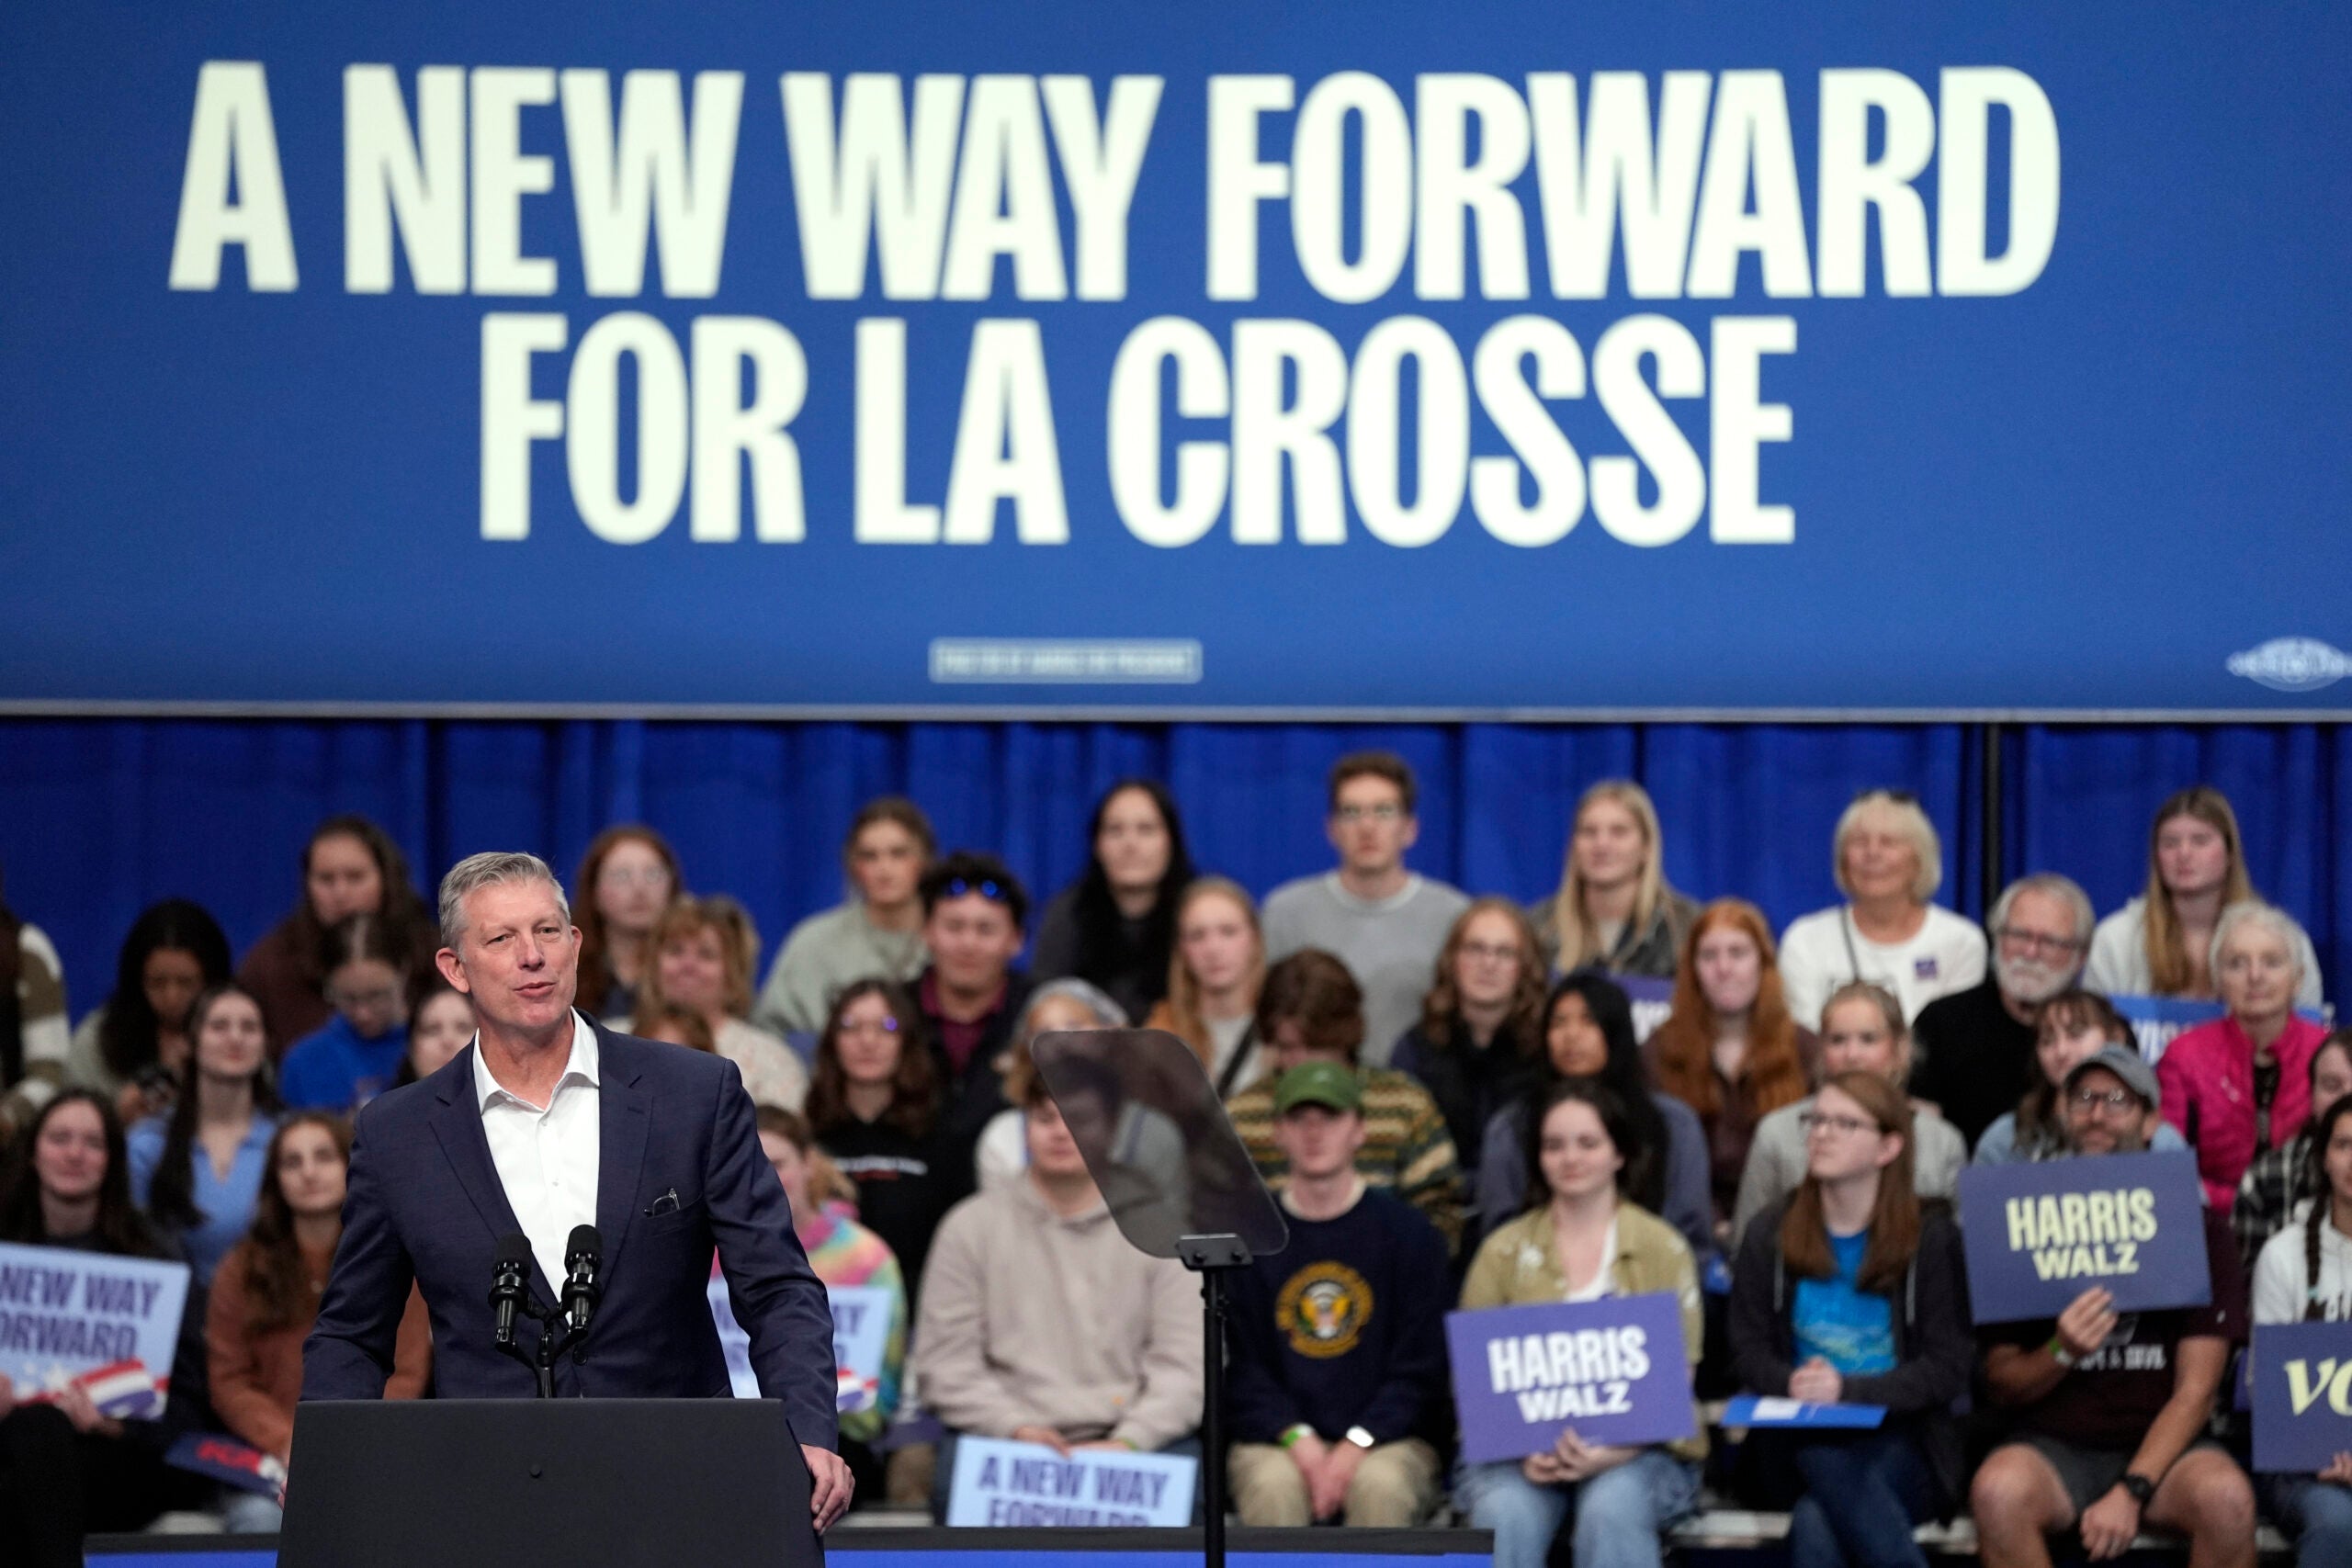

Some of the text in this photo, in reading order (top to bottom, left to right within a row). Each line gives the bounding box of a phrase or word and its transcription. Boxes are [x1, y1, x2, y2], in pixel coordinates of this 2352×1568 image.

[169, 61, 2062, 305] A NEW WAY FORWARD
[480, 311, 1798, 548] FOR LA CROSSE
[2006, 1187, 2157, 1251] HARRIS
[2032, 1241, 2139, 1280] WALZ
[0, 1263, 162, 1320] NEW WAY
[1487, 1325, 1650, 1393] HARRIS
[1517, 1380, 1633, 1423] WALZ
[978, 1455, 1170, 1509] A NEW WAY
